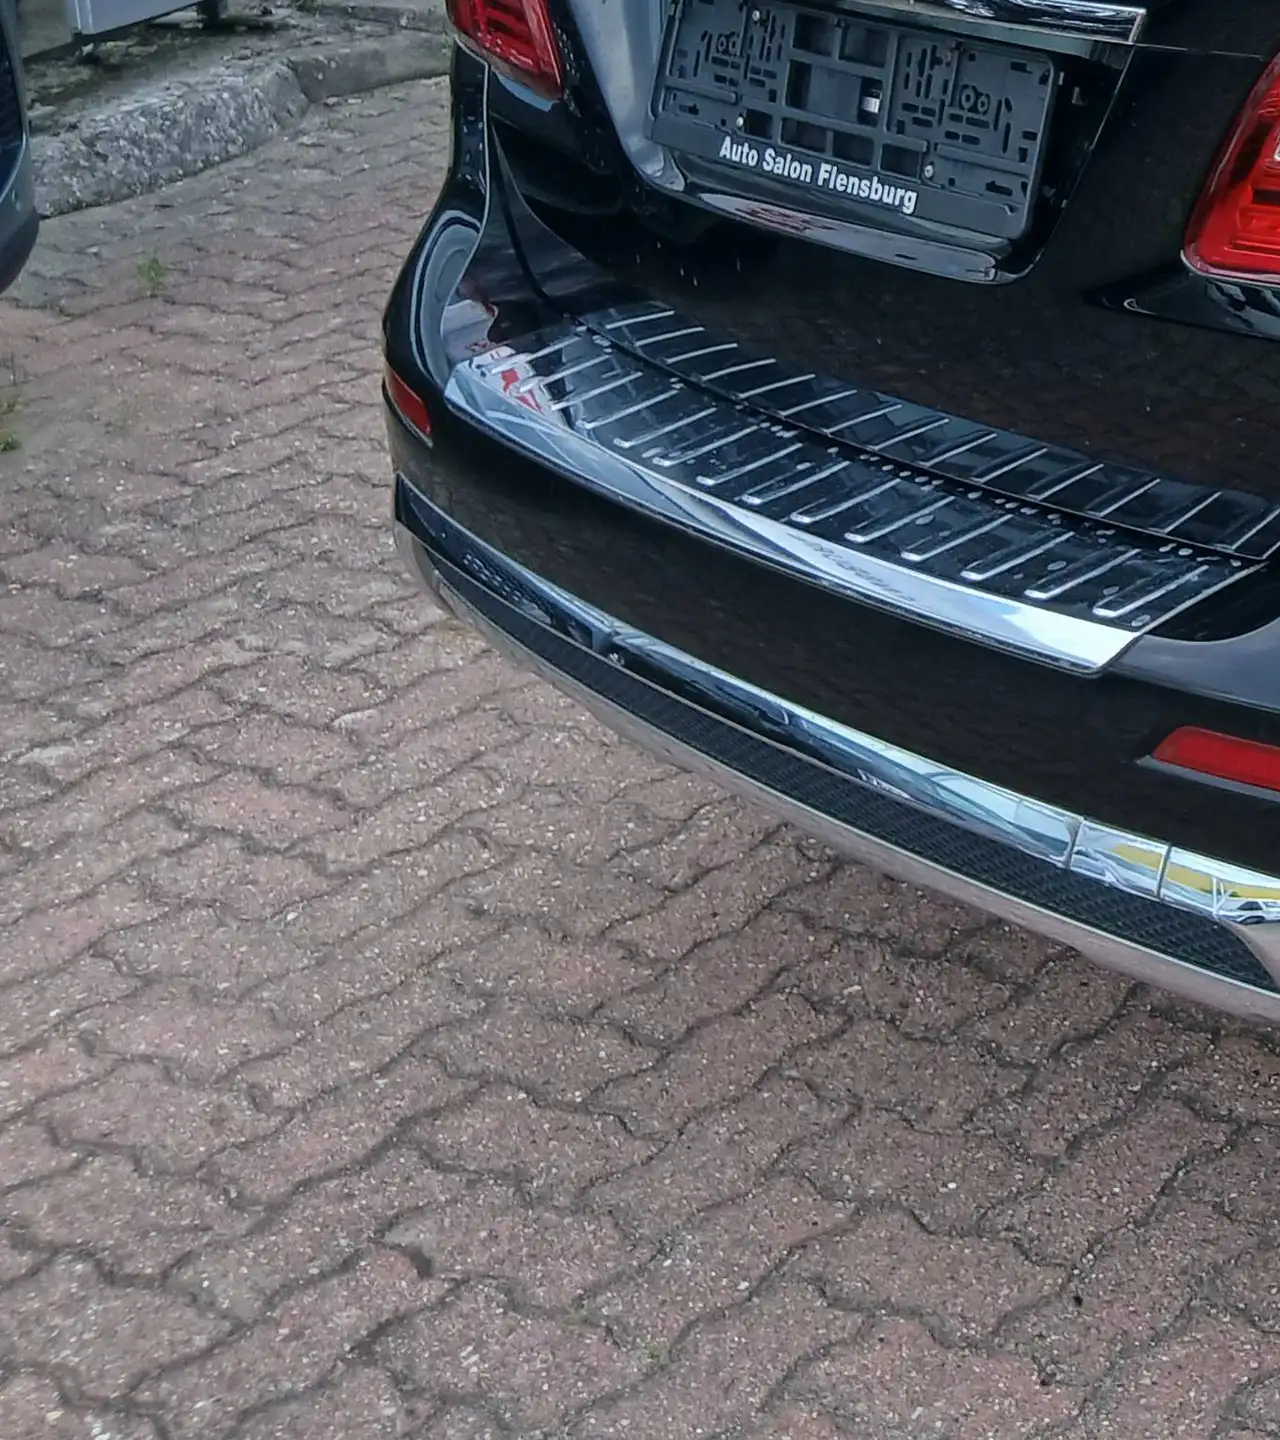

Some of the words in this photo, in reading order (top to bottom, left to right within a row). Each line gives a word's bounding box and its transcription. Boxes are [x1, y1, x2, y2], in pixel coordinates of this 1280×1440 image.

[719, 135, 759, 168] Auto
[762, 146, 813, 184] Salon
[817, 161, 918, 215] Flensburg
